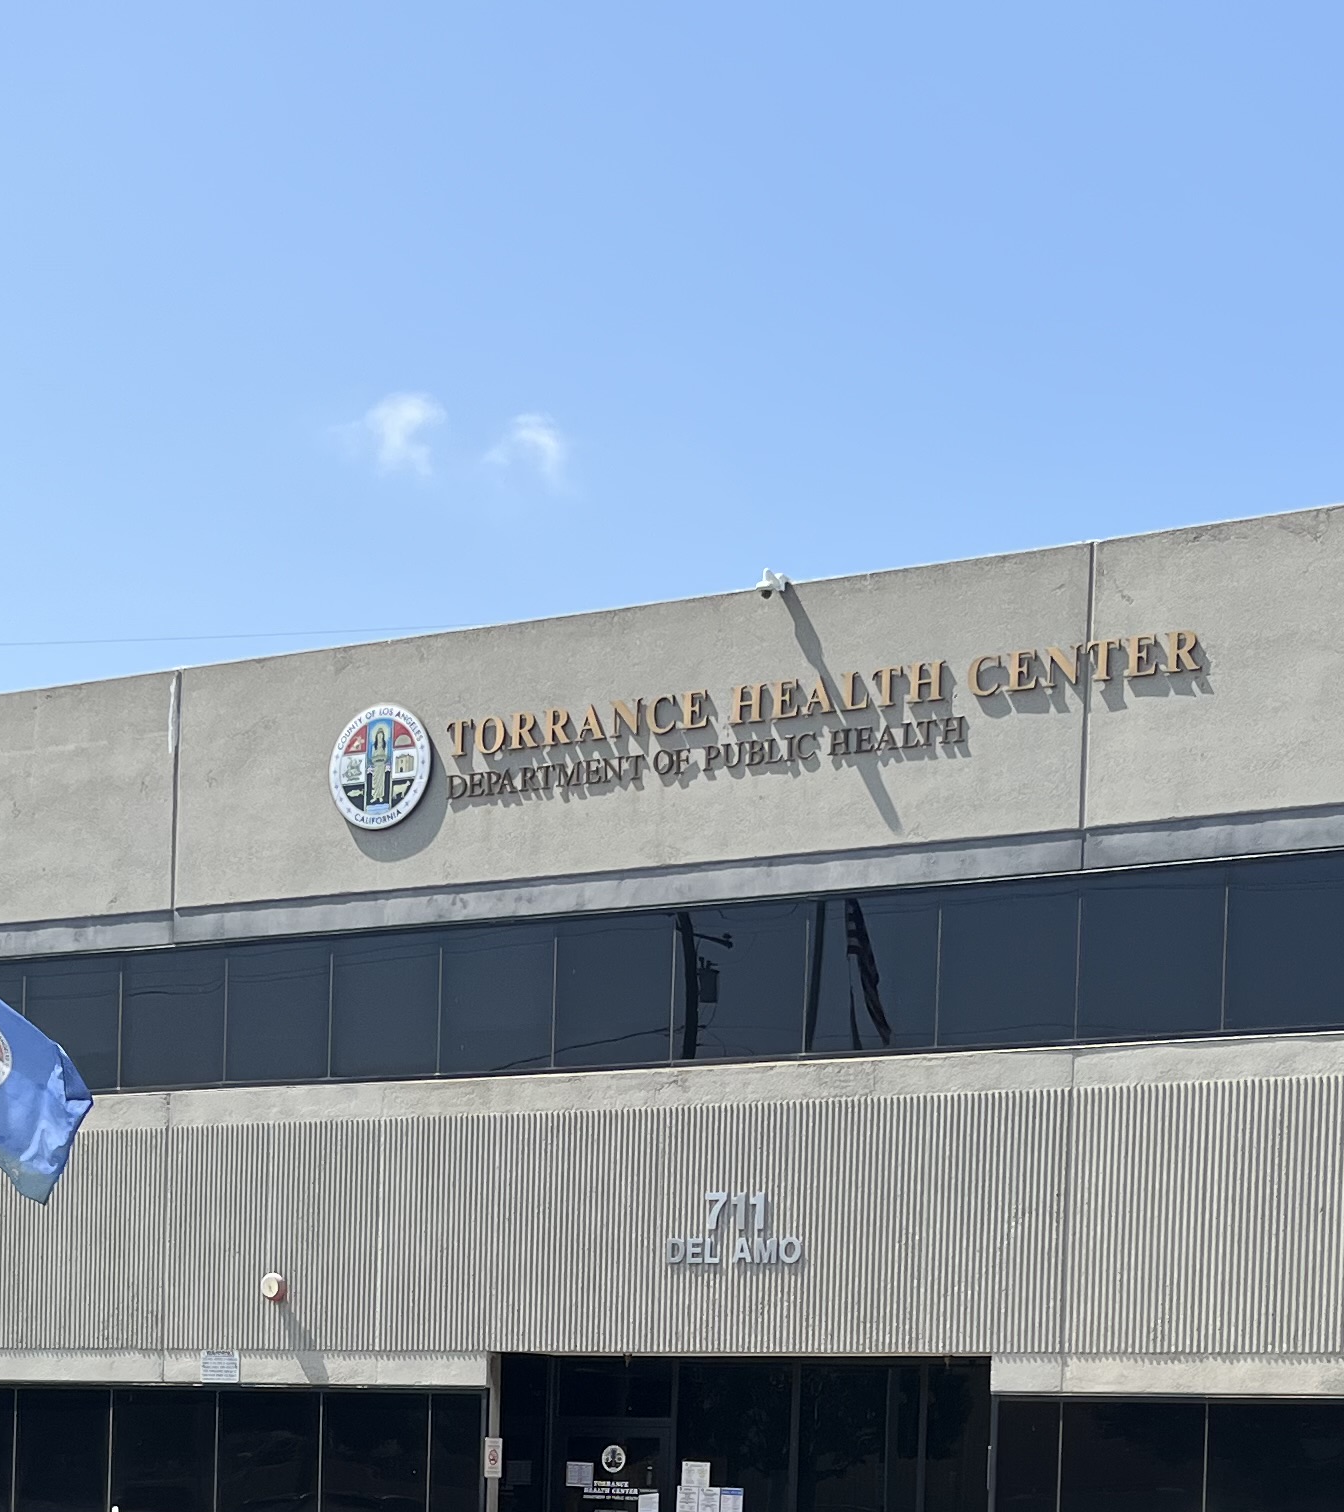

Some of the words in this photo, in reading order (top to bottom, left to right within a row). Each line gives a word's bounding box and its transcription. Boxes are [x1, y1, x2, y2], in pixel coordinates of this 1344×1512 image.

[446, 690, 709, 758] TORRANCE
[728, 660, 947, 726] HEALTH
[967, 630, 1202, 697] CENTER
[337, 717, 365, 751] COUNTY
[365, 709, 376, 720] OF
[379, 707, 394, 717] LOS
[395, 711, 424, 742] ANGELES
[446, 754, 645, 800] DEPARTMENT
[653, 748, 691, 776] OF
[702, 732, 817, 772] PUBLIC
[827, 715, 966, 757] HEALTH
[354, 810, 402, 825] CALIFORNIA
[704, 1191, 766, 1230] 711
[666, 1237, 721, 1264] DEL
[732, 1236, 802, 1264] AMO
